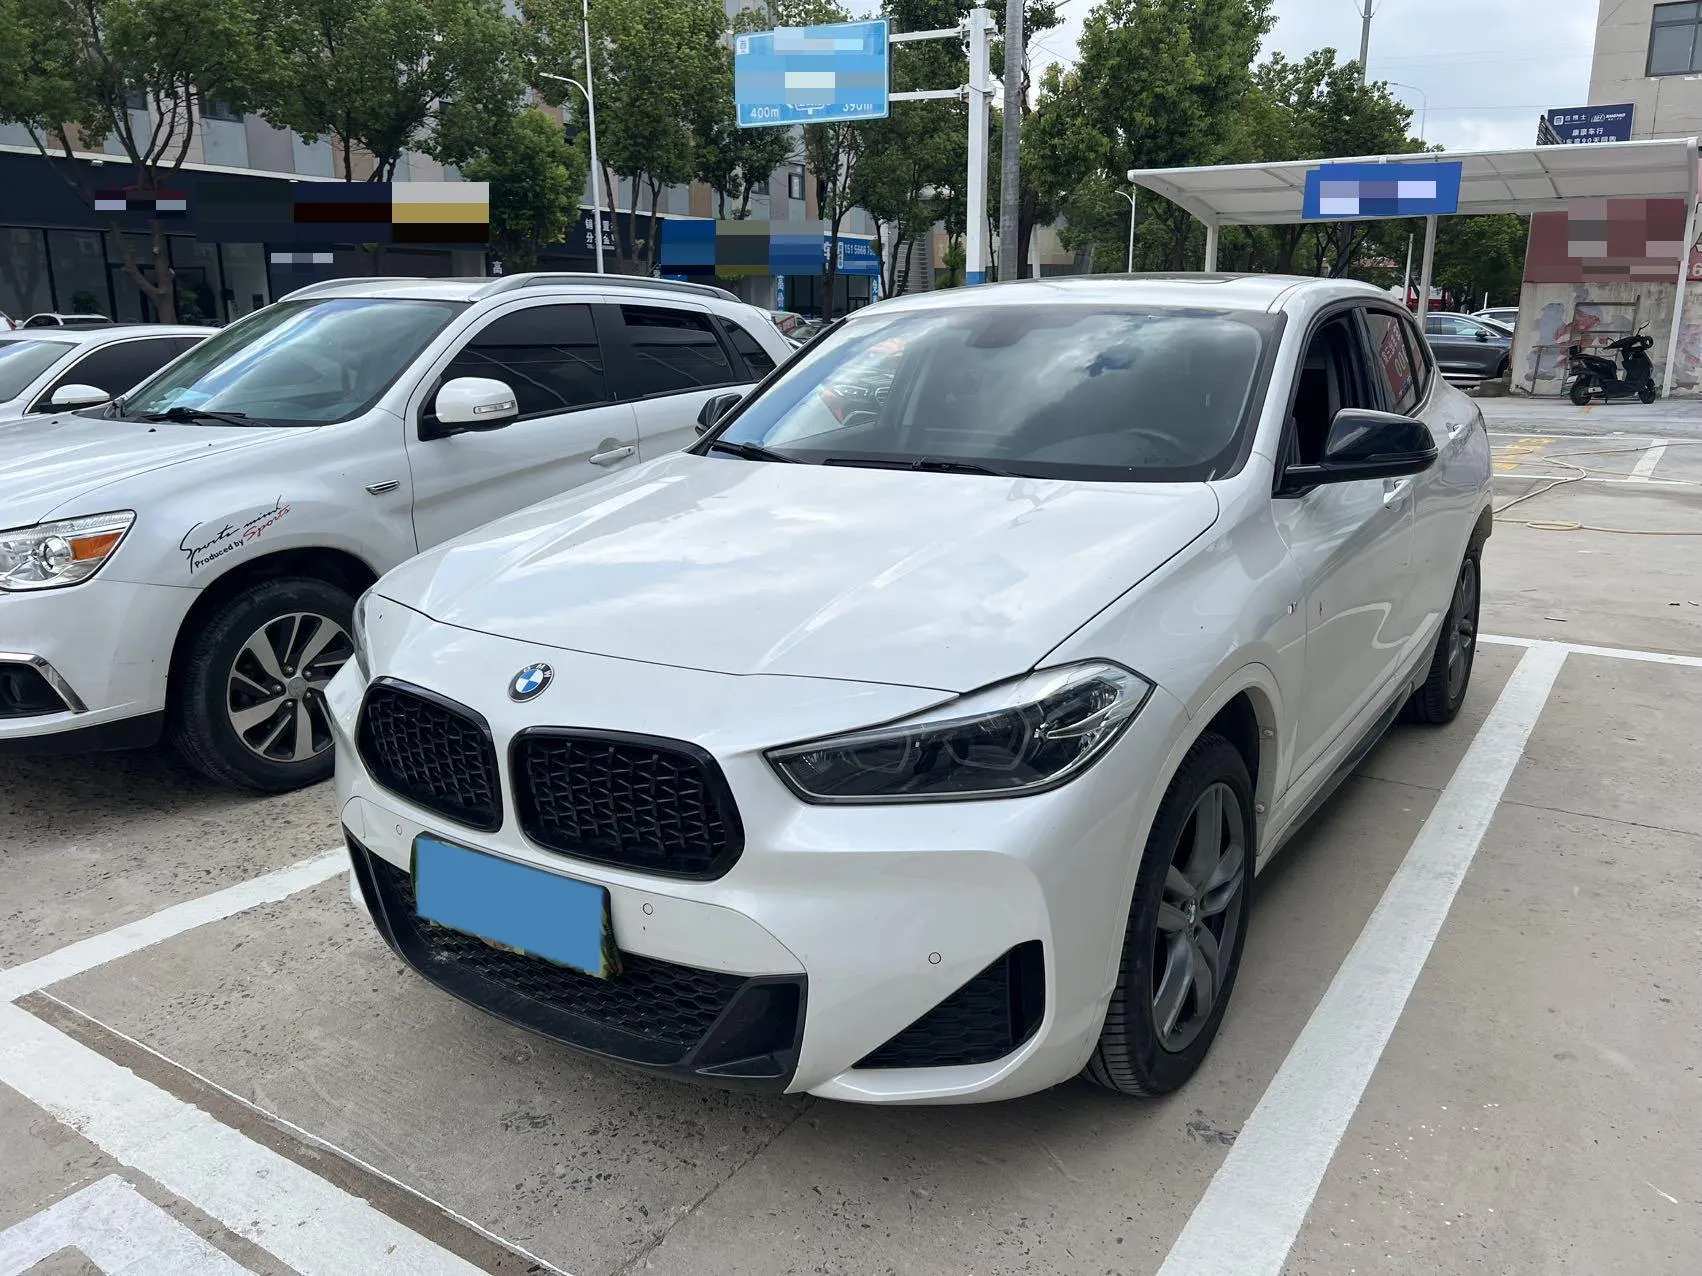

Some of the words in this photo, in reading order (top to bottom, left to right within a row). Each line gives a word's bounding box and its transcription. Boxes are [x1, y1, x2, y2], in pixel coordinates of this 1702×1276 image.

[750, 106, 779, 119] 400m
[194, 543, 234, 568] Produced
[233, 538, 244, 548] by
[243, 504, 292, 541] Sports
